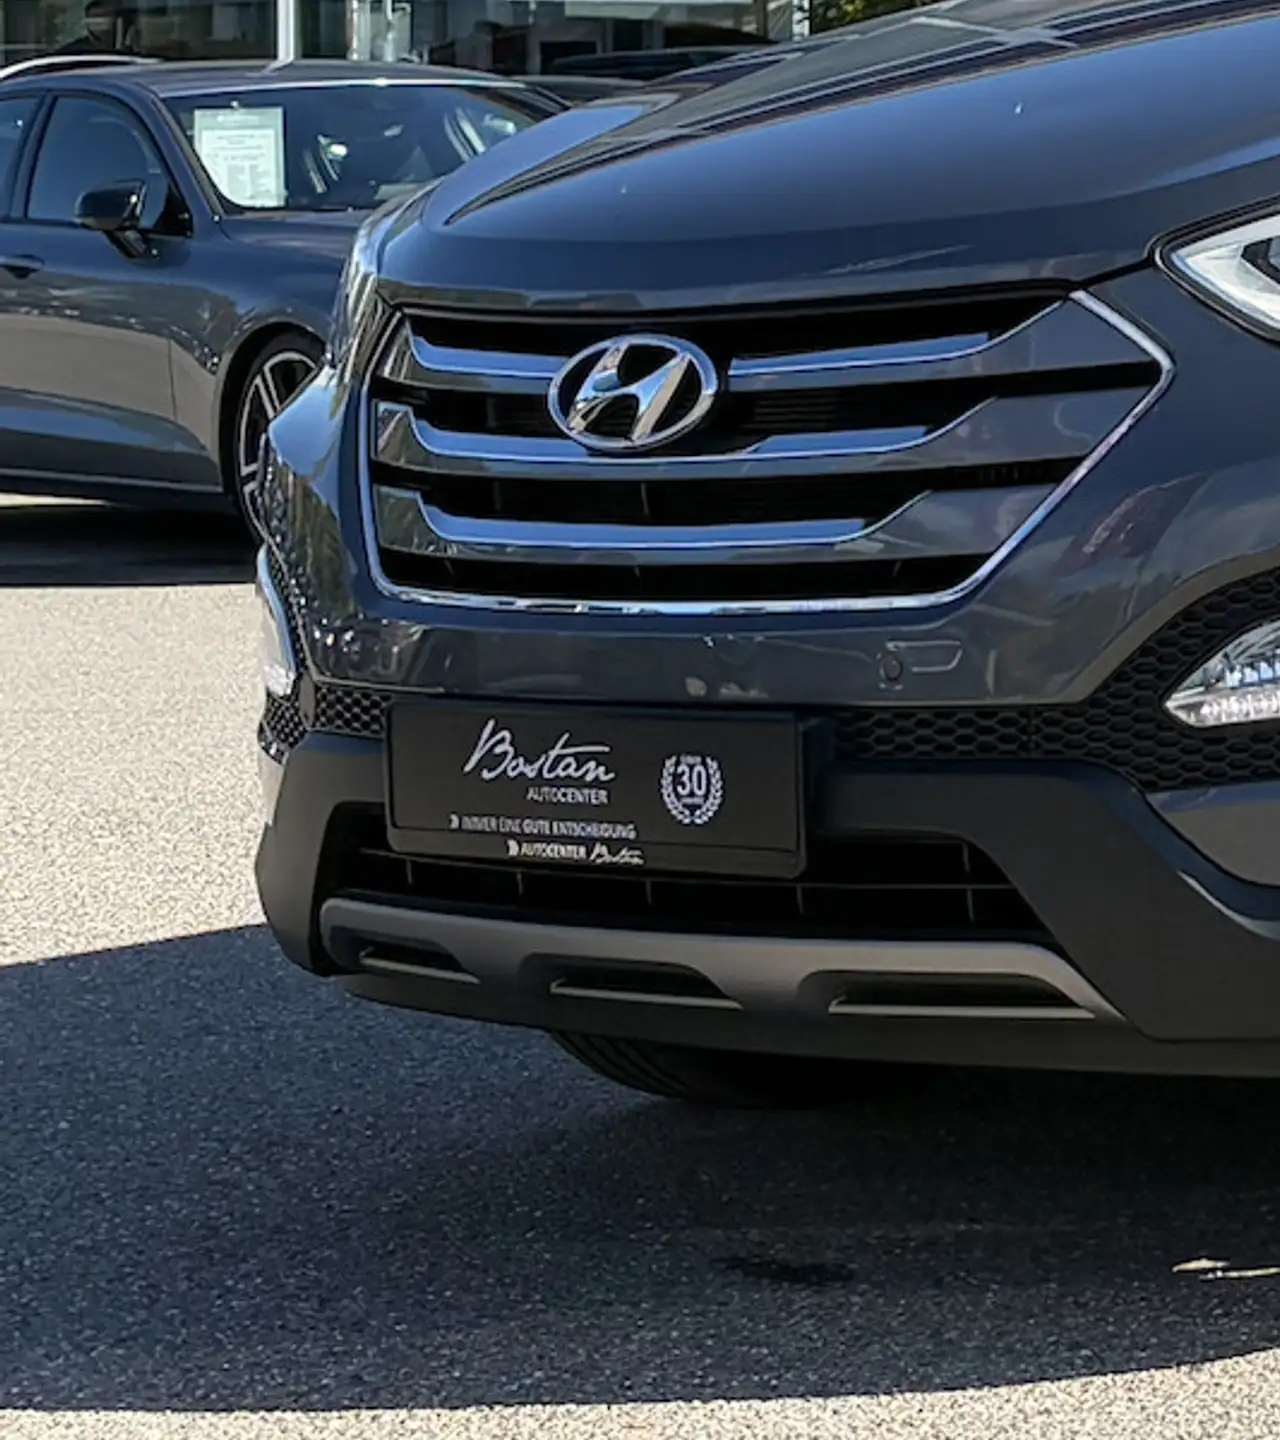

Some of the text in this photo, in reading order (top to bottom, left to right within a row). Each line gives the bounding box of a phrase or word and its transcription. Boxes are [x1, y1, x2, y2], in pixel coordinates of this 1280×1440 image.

[463, 718, 617, 783] Bostan
[525, 786, 609, 805] AUTOCENTER
[676, 763, 707, 796] 30
